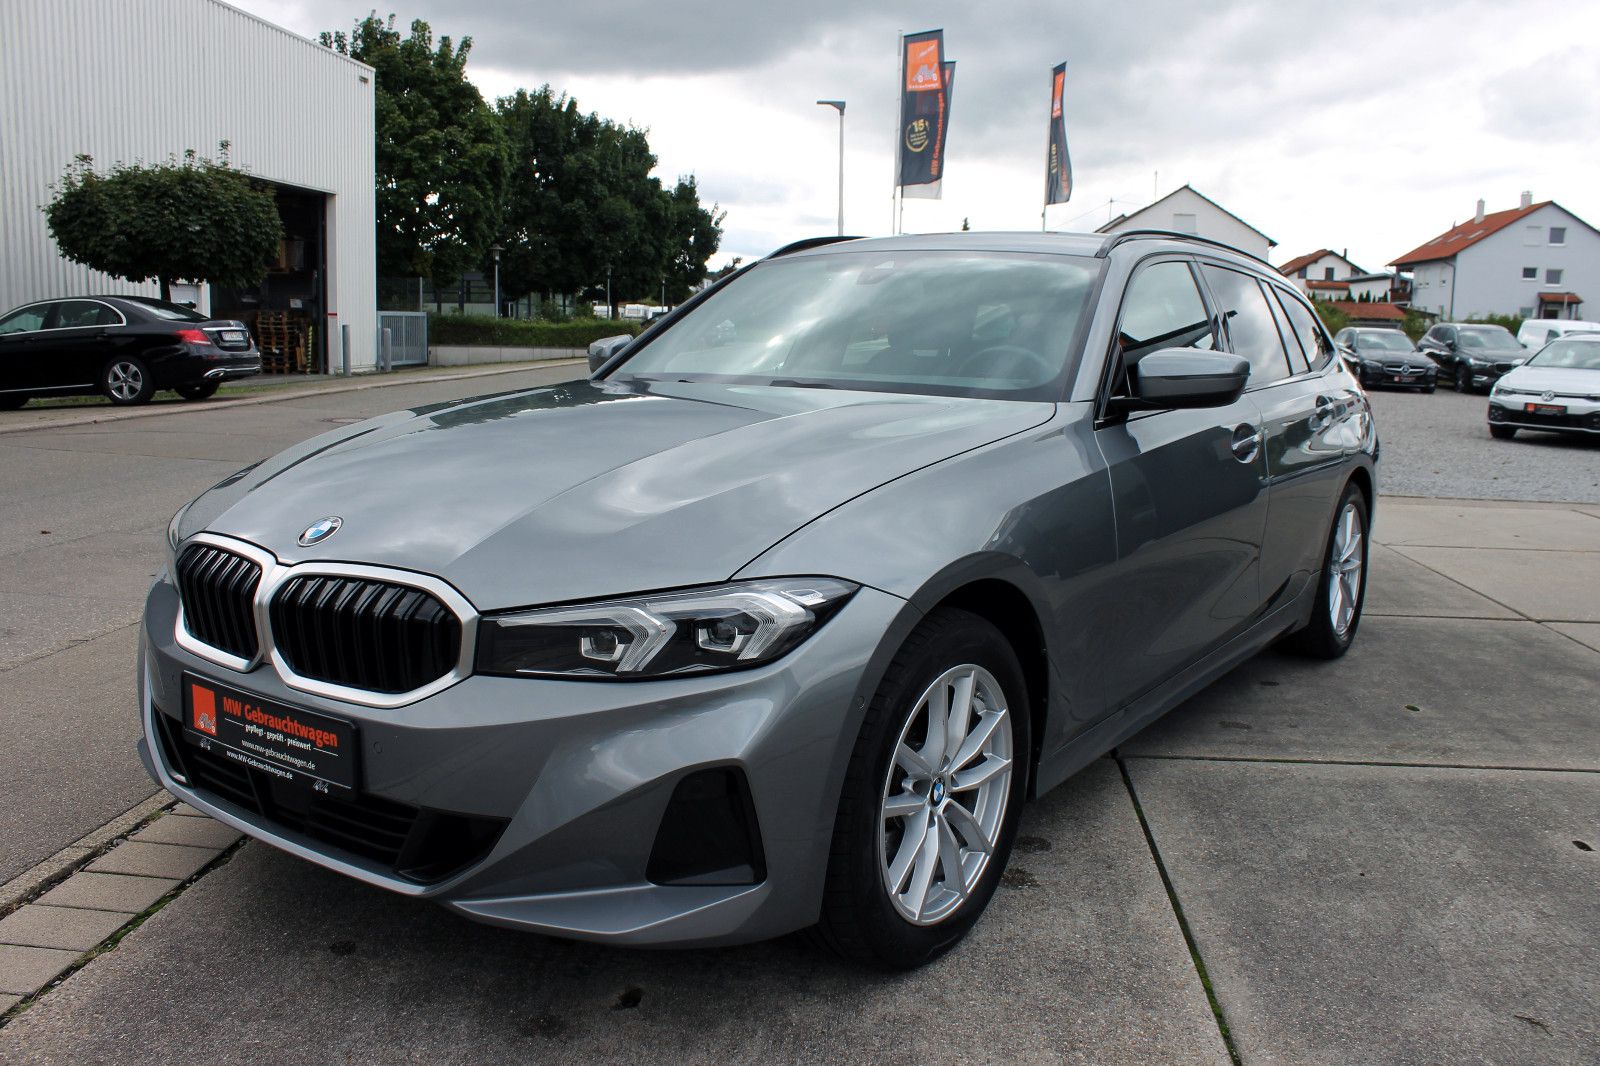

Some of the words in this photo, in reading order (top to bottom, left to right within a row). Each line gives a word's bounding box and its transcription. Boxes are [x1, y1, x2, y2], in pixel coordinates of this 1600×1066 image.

[224, 697, 242, 717] MW
[244, 704, 337, 747] Gebrauchtwagen
[245, 724, 264, 737] gepflegt
[266, 731, 284, 743] geprüft
[287, 737, 312, 751] preiswert
[241, 739, 316, 770] www.mw-gebrauchtwagen.de
